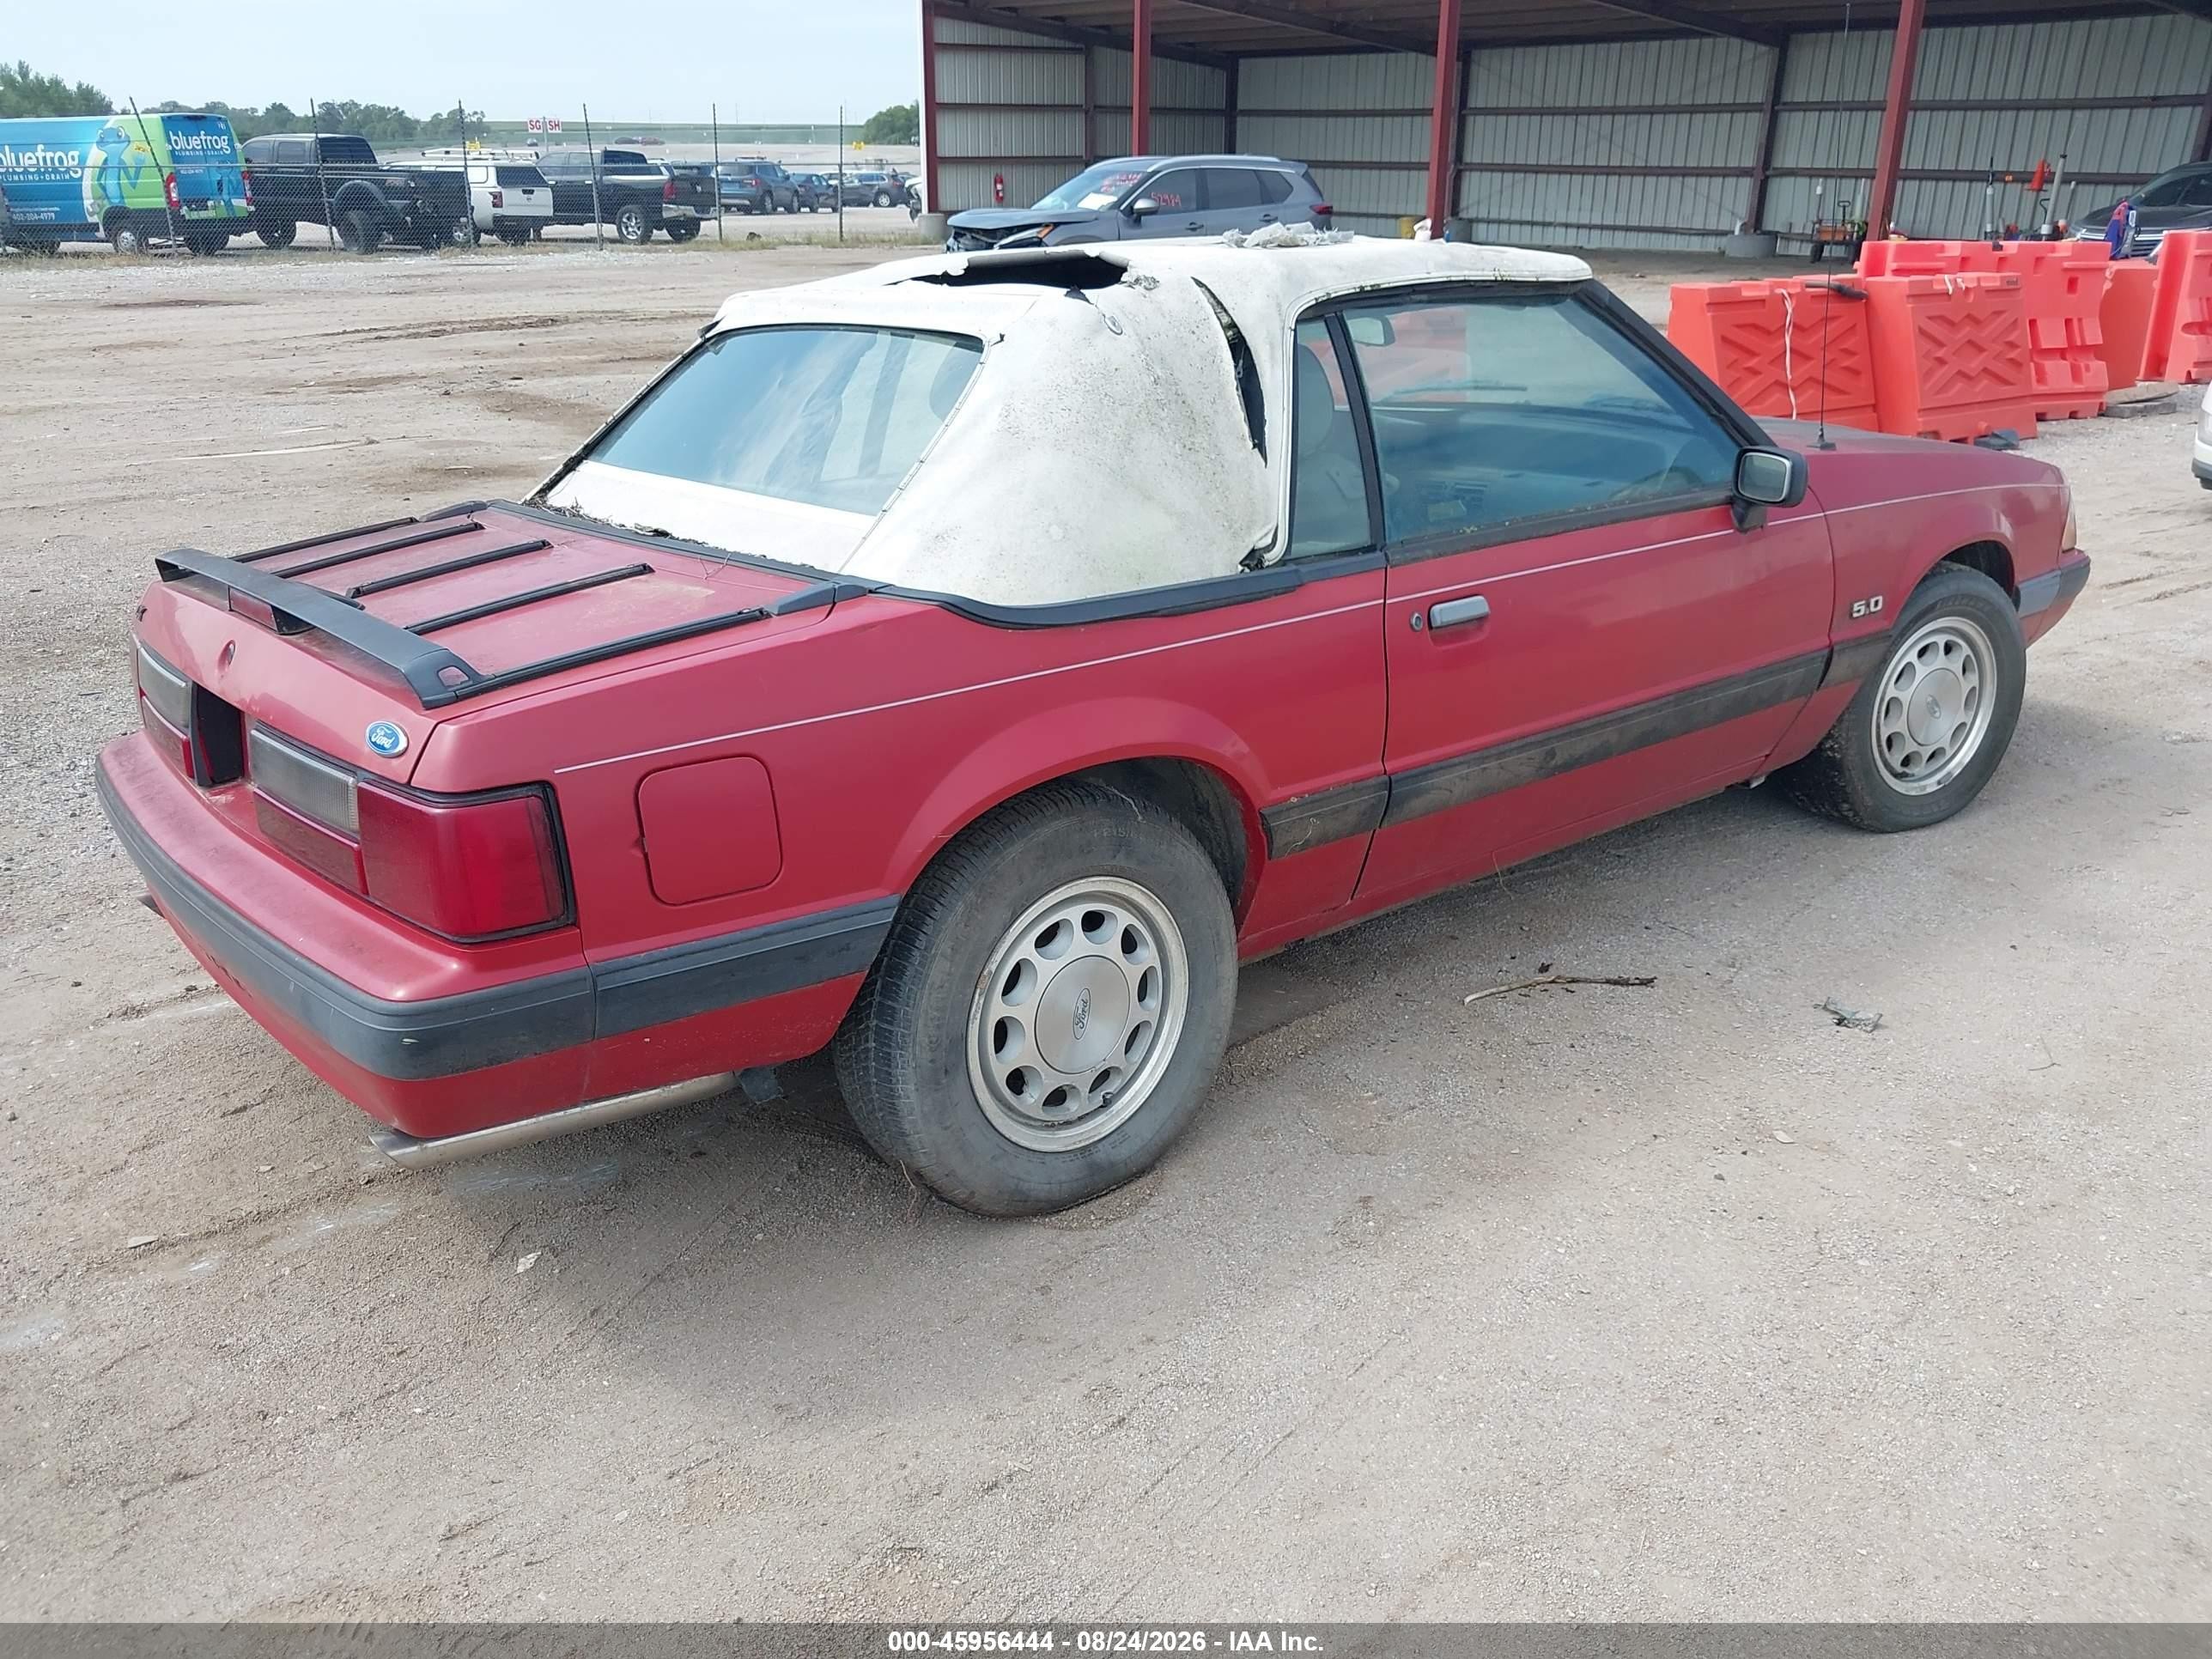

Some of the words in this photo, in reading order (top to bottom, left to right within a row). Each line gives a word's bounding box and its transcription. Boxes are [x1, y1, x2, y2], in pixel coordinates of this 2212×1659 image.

[529, 120, 542, 131] SG
[548, 120, 561, 131] SH
[169, 131, 231, 154] bluefrog
[1852, 595, 1883, 618] 5.0
[371, 726, 396, 749] Ford
[1075, 999, 1089, 1030] Ford
